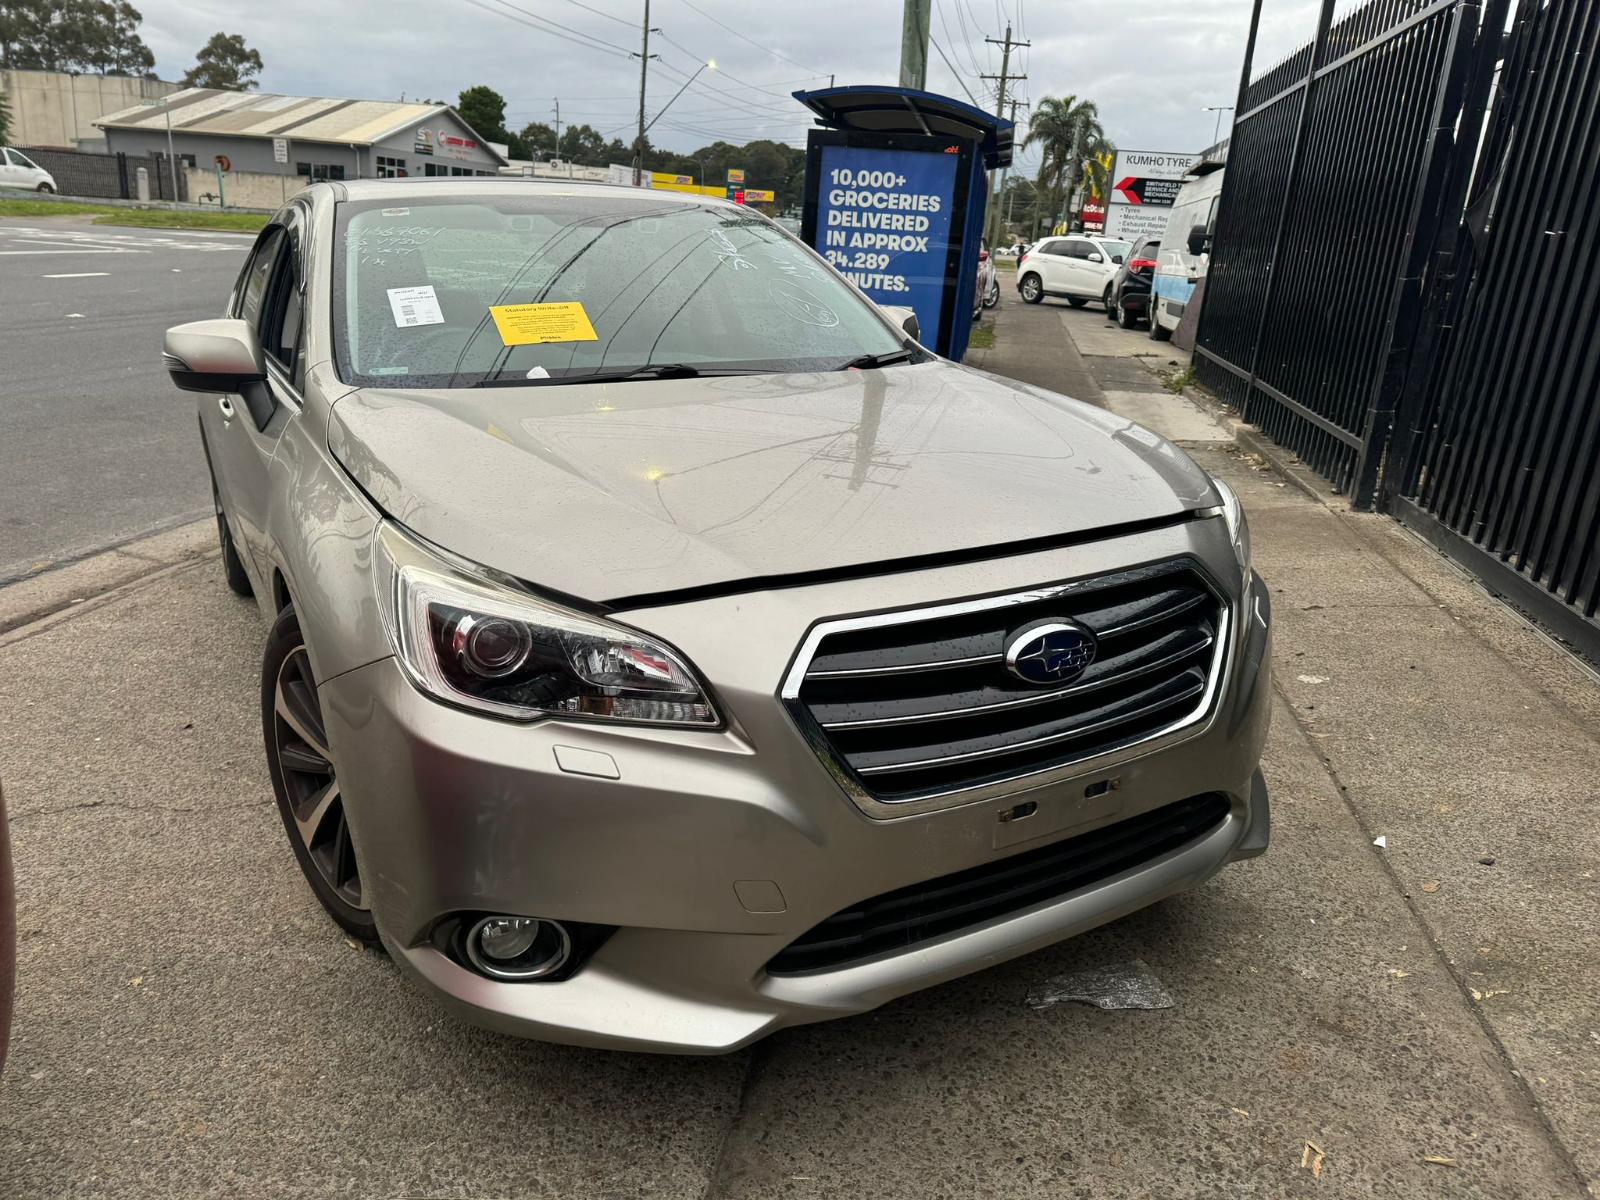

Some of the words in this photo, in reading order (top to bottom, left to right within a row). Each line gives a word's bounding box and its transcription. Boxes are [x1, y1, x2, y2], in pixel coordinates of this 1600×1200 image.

[1126, 155, 1164, 166] KUMHO
[1166, 157, 1192, 168] TYRE
[830, 168, 906, 189] 10,000+
[829, 189, 941, 212] GROCERIES
[1143, 191, 1176, 199] MECHANICA
[828, 209, 929, 231] DELIVERED
[1123, 213, 1157, 221] Mechanical
[826, 230, 846, 246] IN
[849, 232, 928, 253] APPROX
[825, 250, 889, 270] 34.289
[841, 271, 910, 292] NUTES.
